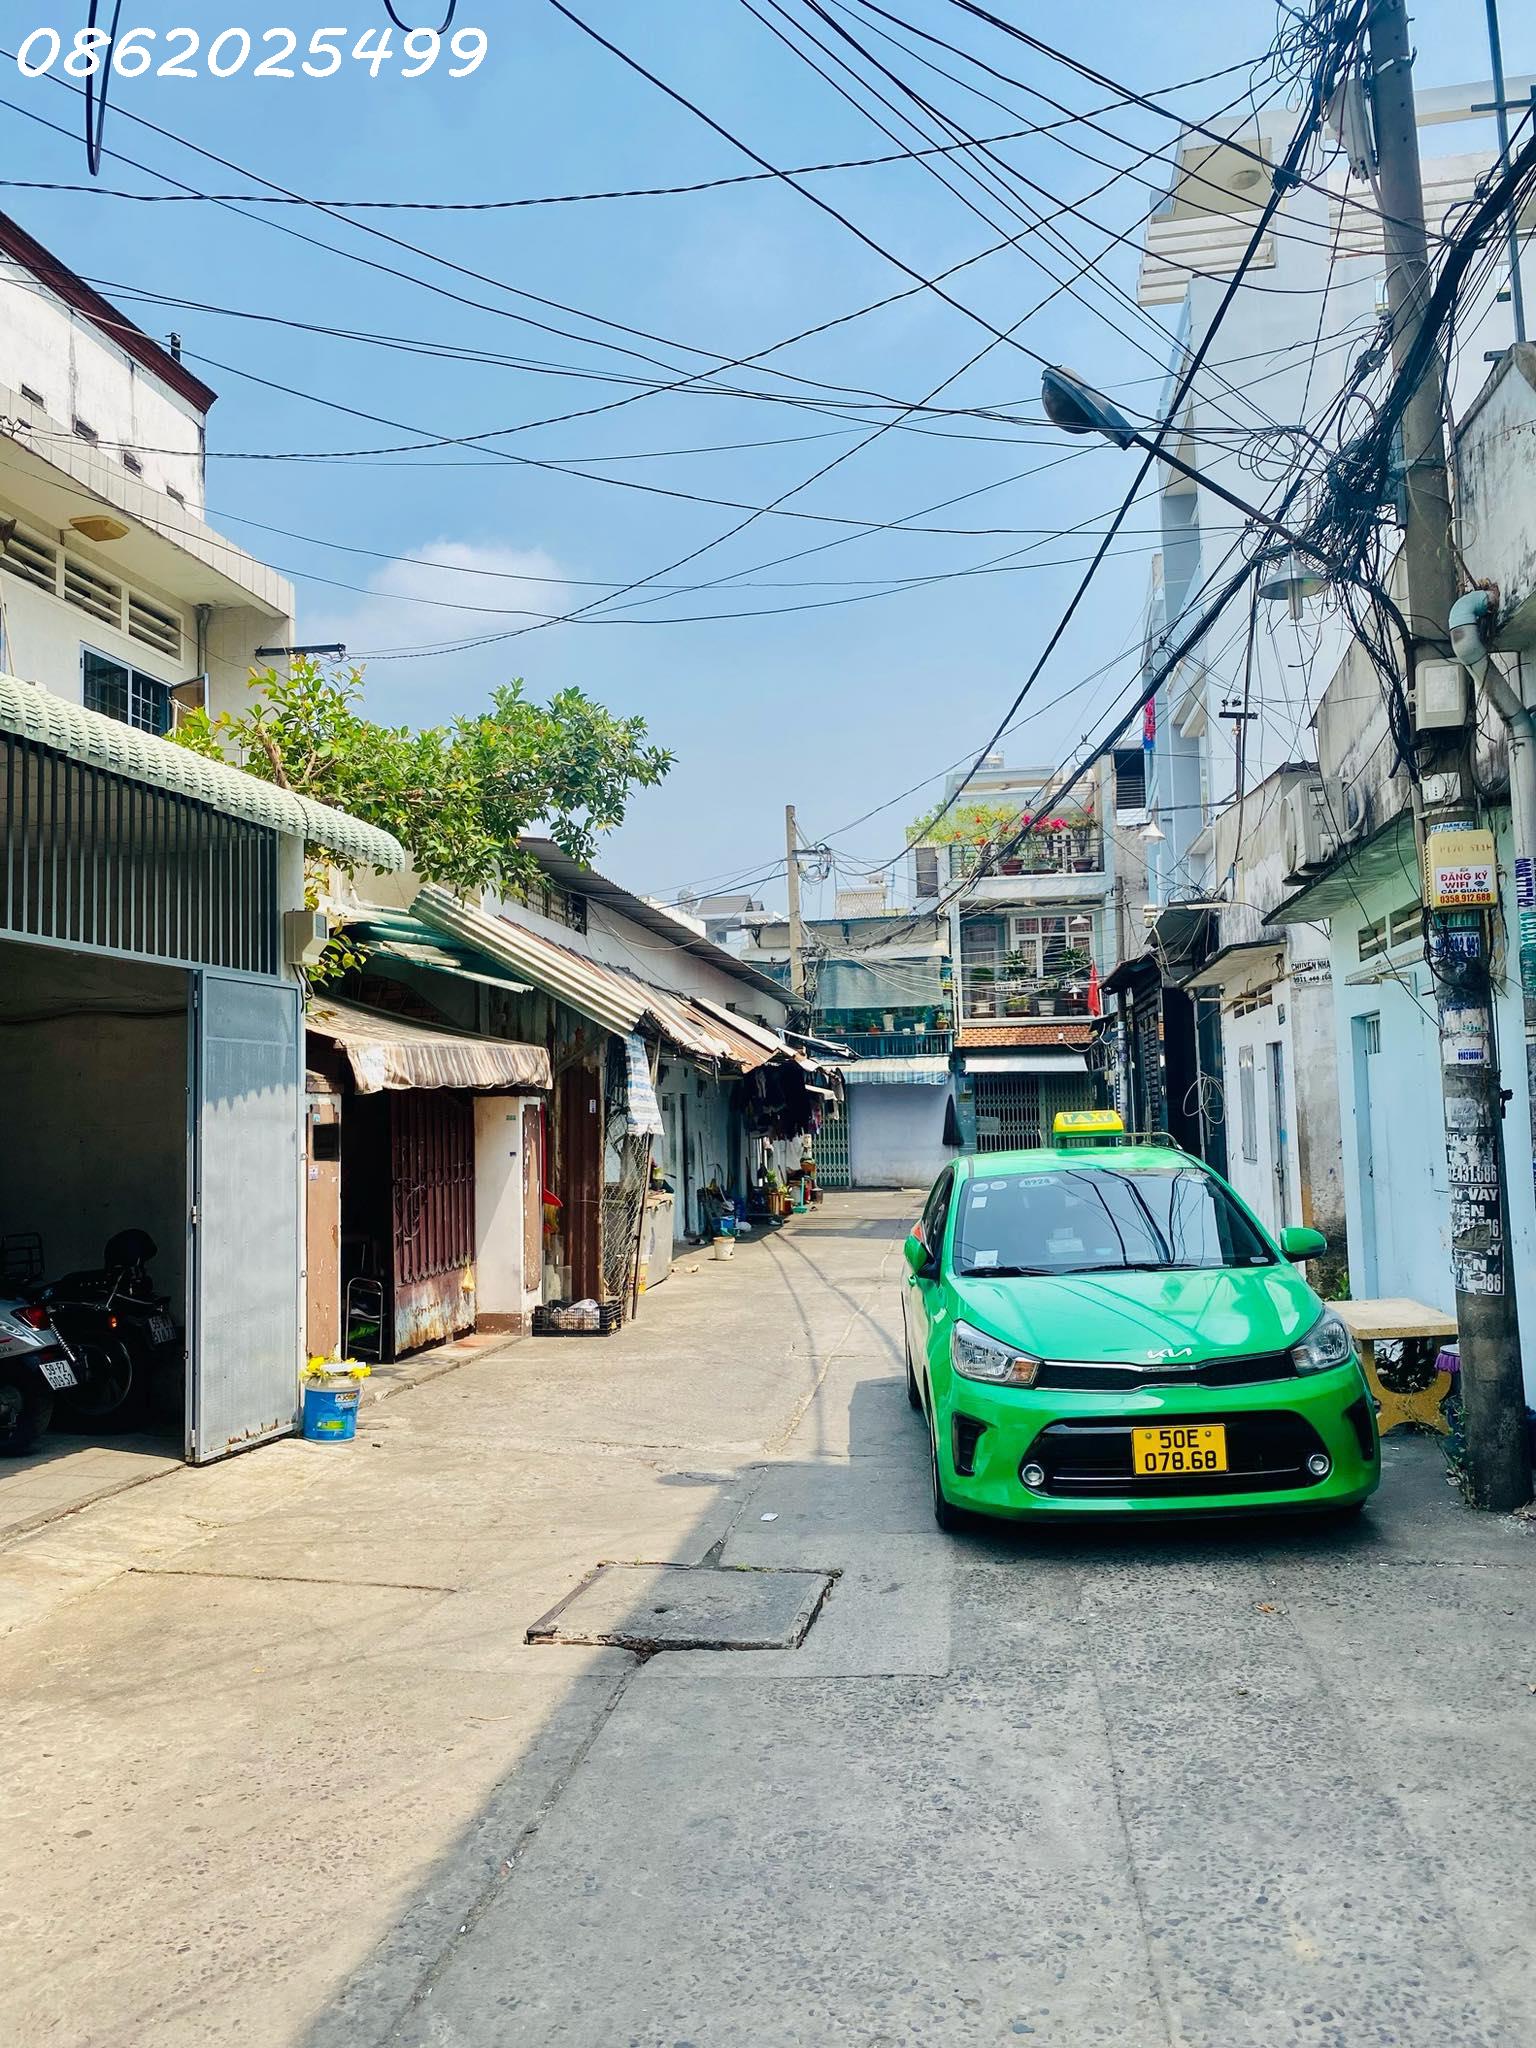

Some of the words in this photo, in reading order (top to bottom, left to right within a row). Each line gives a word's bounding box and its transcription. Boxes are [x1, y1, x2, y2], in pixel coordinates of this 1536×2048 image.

[1440, 871, 1472, 882] ĐĂNG
[1445, 881, 1469, 889] WIFI
[1147, 1347, 1193, 1360] KIA
[1159, 1429, 1200, 1449] 50E
[1144, 1450, 1217, 1471] 078.68
